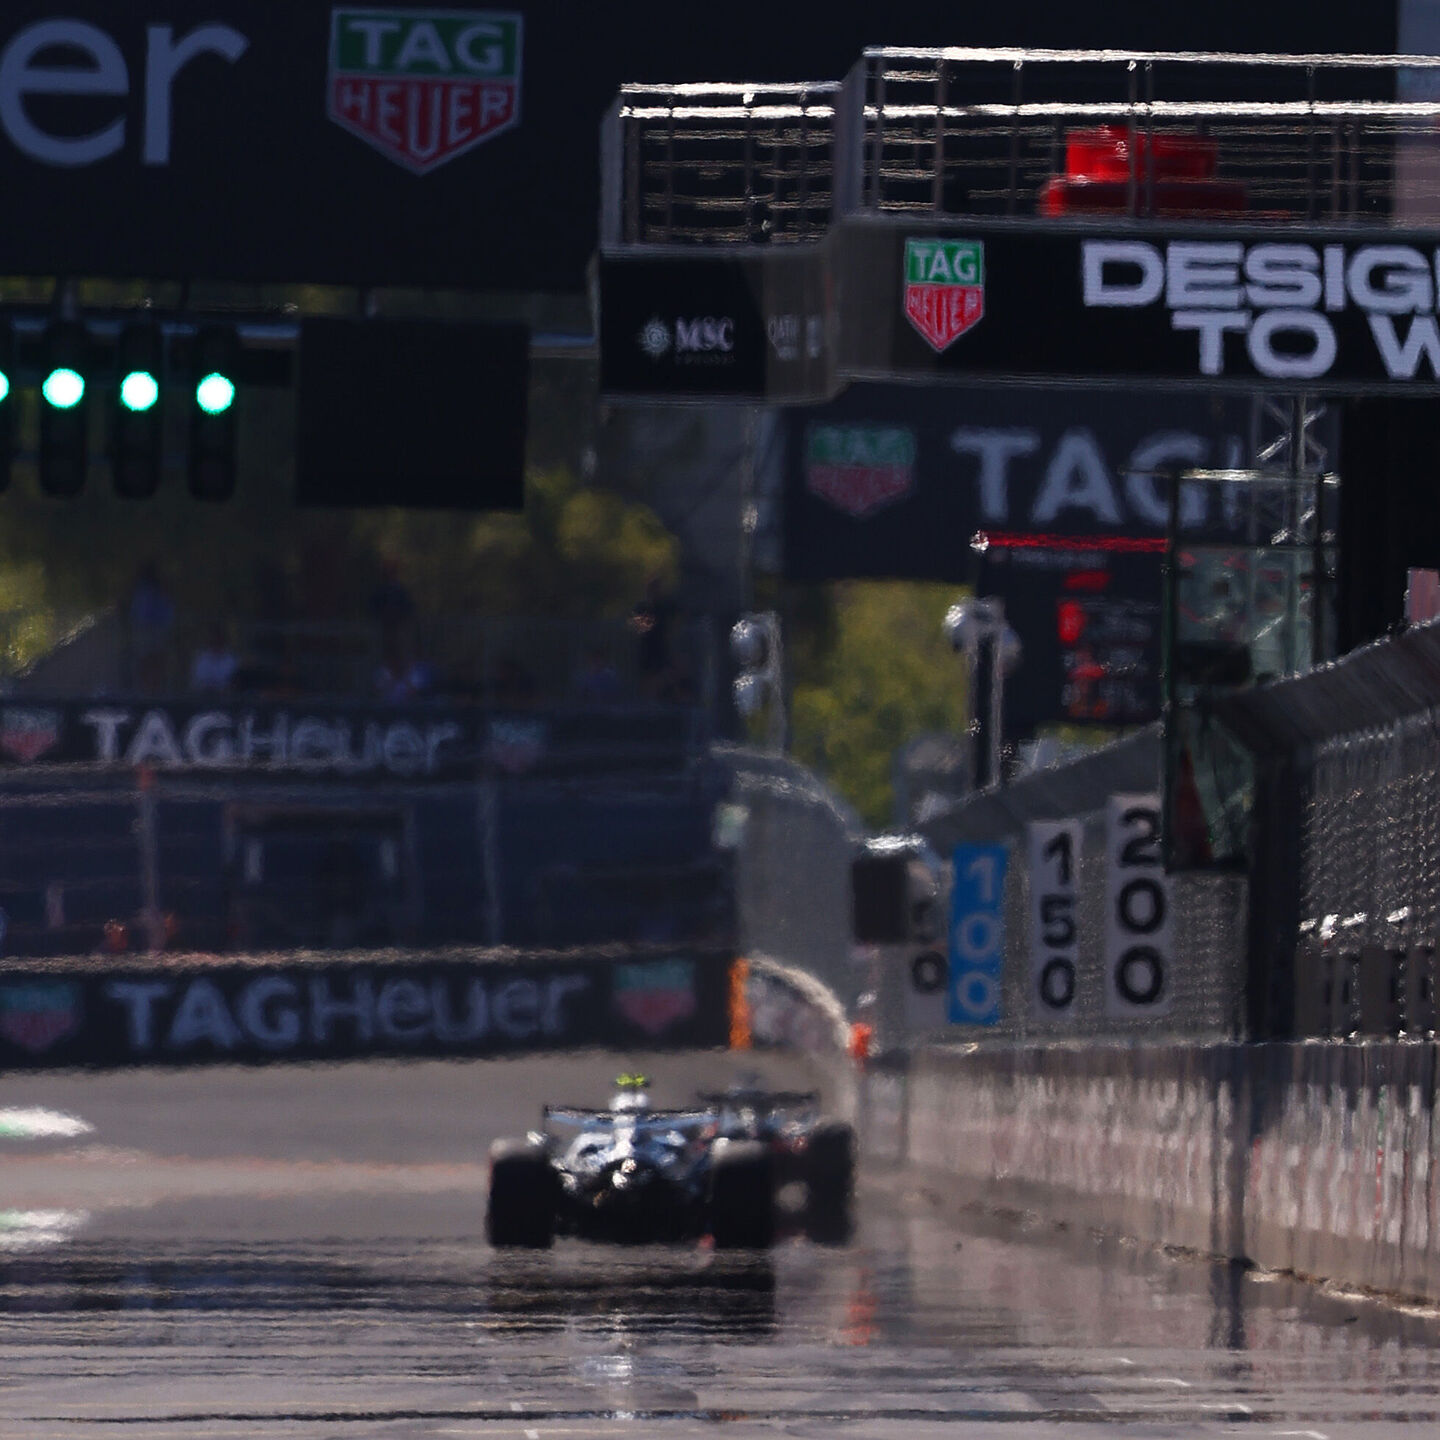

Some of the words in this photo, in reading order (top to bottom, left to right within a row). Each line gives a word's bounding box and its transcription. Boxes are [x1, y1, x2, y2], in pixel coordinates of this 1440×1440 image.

[346, 19, 504, 71] TAG
[341, 80, 509, 158] HEUER
[913, 248, 978, 281] TAG
[1082, 239, 1440, 311] DESIG
[1171, 308, 1337, 380] TO
